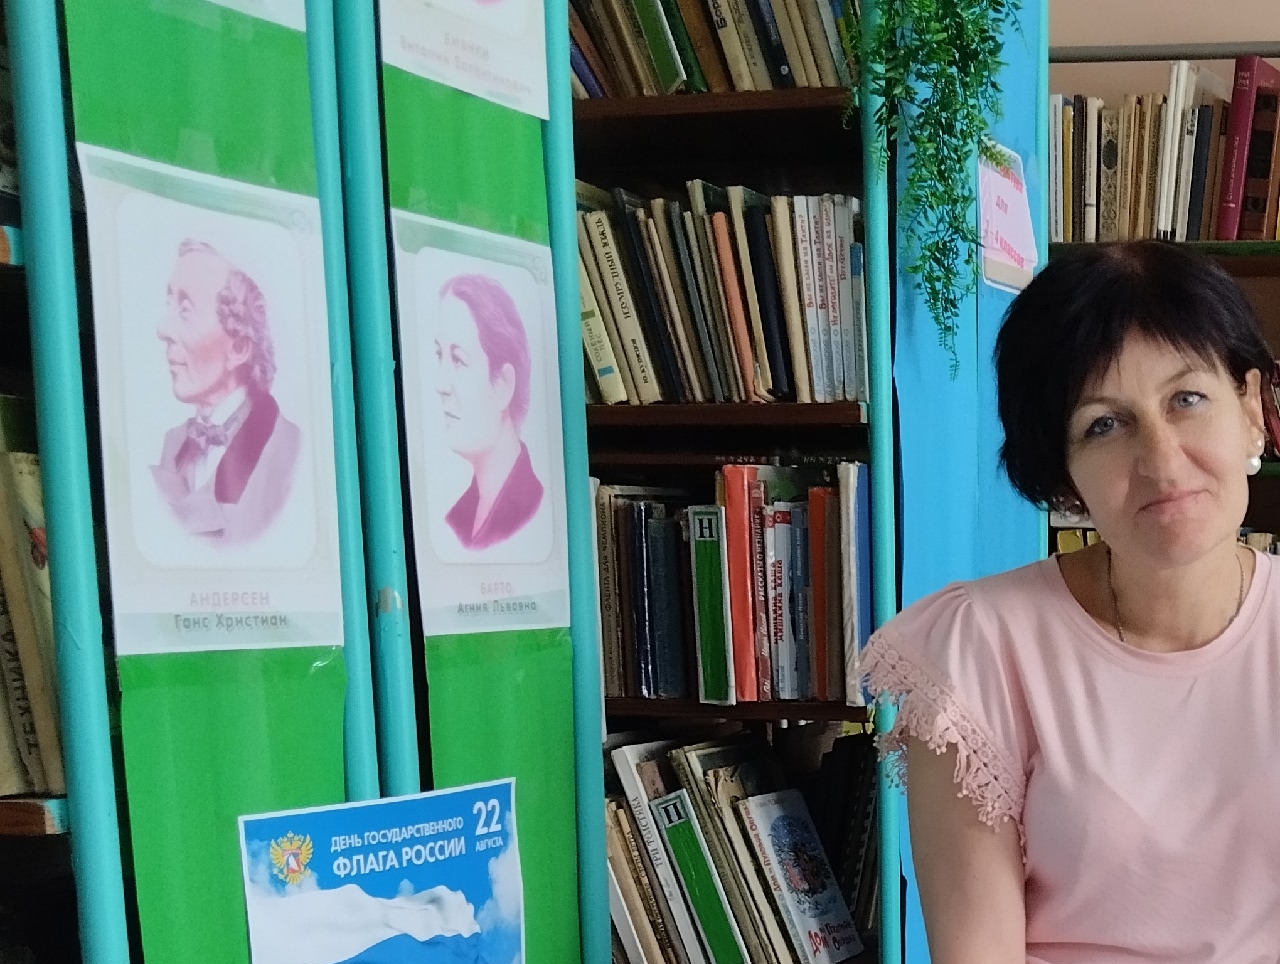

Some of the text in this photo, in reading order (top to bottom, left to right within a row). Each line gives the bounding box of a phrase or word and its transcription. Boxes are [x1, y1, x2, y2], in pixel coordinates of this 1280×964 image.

[595, 216, 611, 249] ДОЖДЬ
[604, 251, 632, 320] ИЗУМРУДНЫЙ
[697, 517, 716, 539] Н
[190, 591, 271, 608] АНДЕРСЕН
[480, 582, 513, 596] БАРТО
[457, 598, 537, 615] Агния Львовна
[174, 612, 288, 631] Ганс Христиан
[472, 799, 502, 836] 22
[628, 796, 658, 847] ТОЛСТЯКА
[662, 801, 685, 824] П
[330, 816, 504, 853] ДЕНЬ ГОСУДАРСТВЕННОГО АВГУСТА
[332, 836, 466, 878] ФЛАГА РОССИИ
[649, 847, 665, 869] ТРИ
